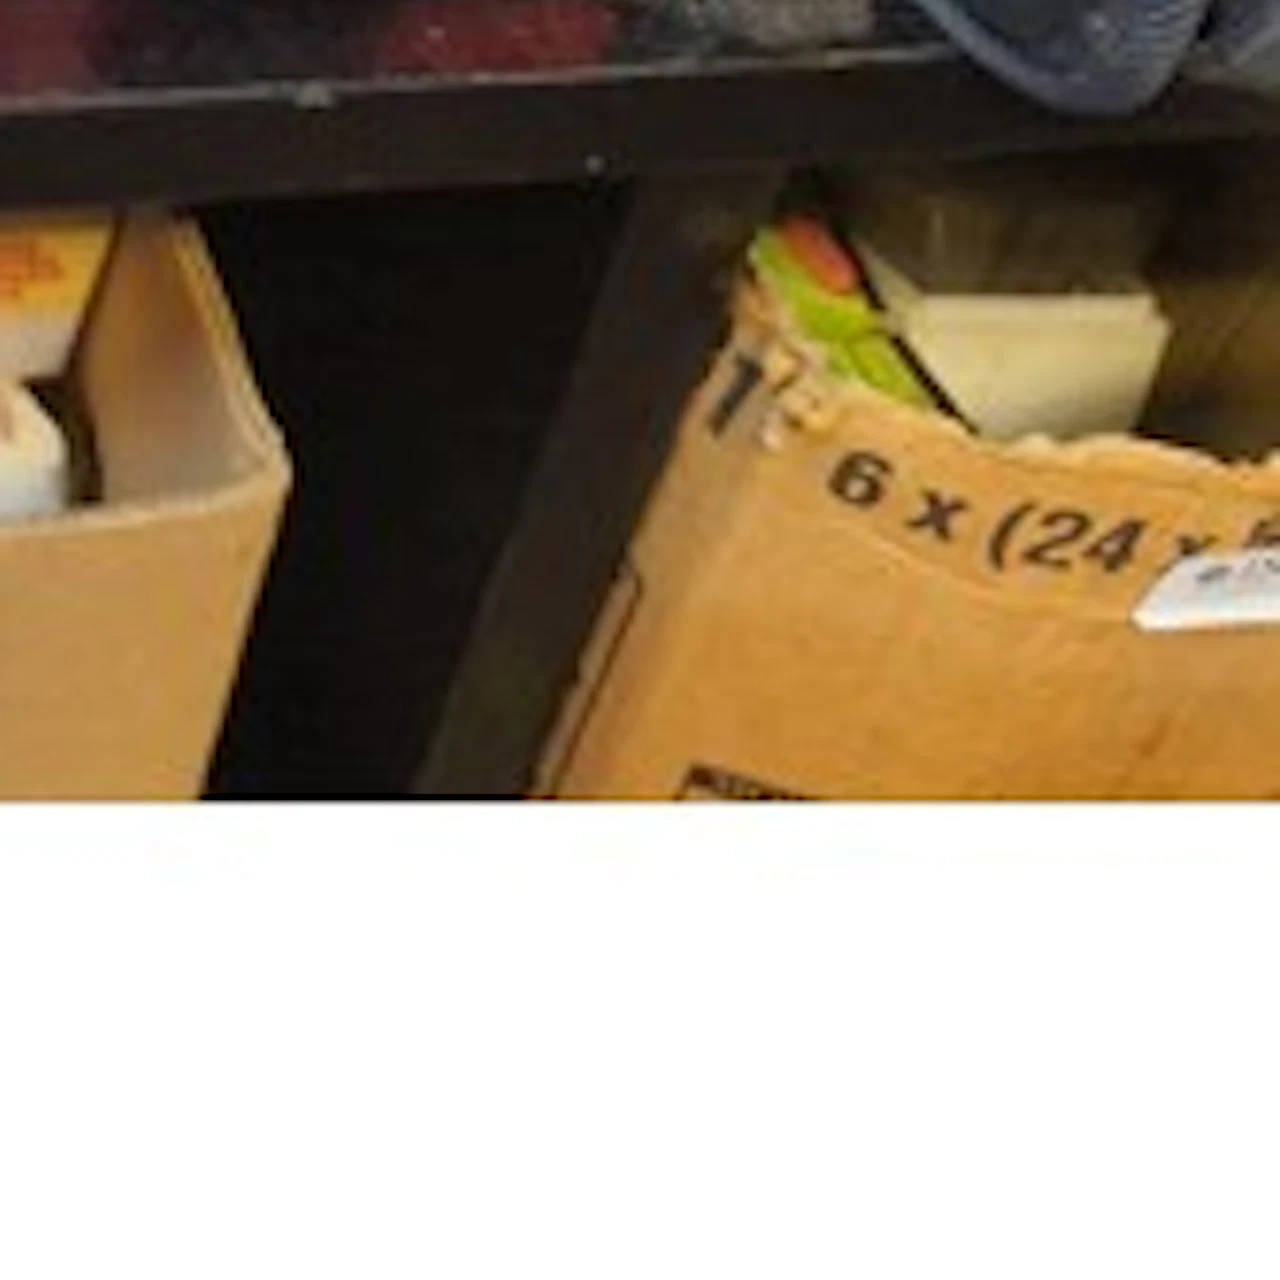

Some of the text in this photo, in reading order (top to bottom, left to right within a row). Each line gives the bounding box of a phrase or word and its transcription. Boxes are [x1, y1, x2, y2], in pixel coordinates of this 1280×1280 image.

[828, 451, 893, 510] 6
[905, 488, 971, 542] x
[987, 498, 1149, 573] (24
